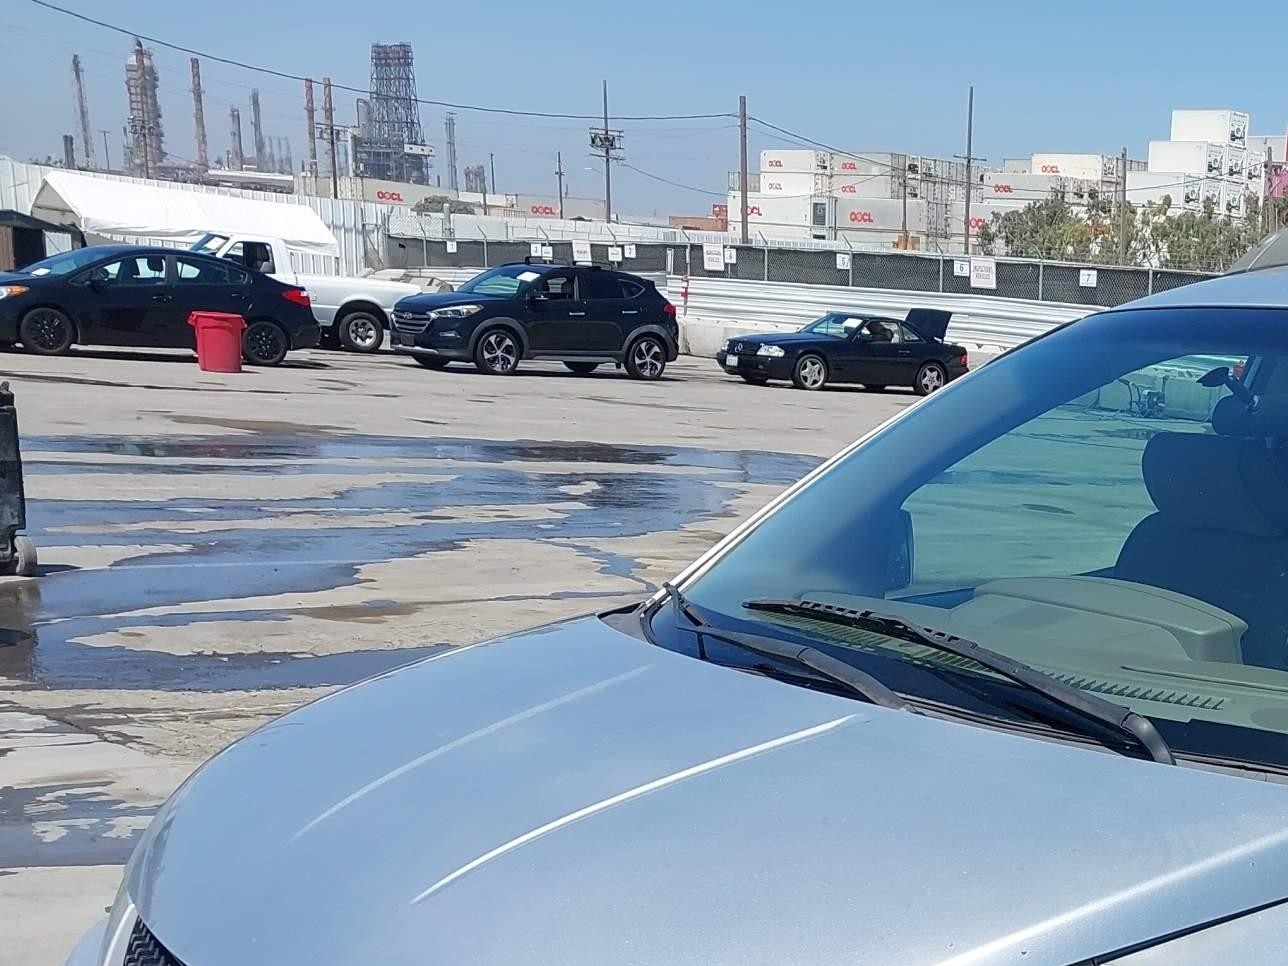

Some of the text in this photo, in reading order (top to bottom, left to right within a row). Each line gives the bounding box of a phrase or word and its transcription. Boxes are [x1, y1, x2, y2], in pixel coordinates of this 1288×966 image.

[768, 160, 783, 168] OOCL
[841, 162, 857, 170] OOCL
[1041, 165, 1060, 173] OOCL
[768, 183, 783, 191] OOCL
[841, 185, 857, 193] OOCL
[994, 184, 1013, 193] OOCL
[377, 191, 403, 201] OOCL
[531, 205, 556, 215] OOCL
[746, 205, 762, 217] OCL
[849, 211, 873, 222] OOCL
[1086, 274, 1091, 283] 7
